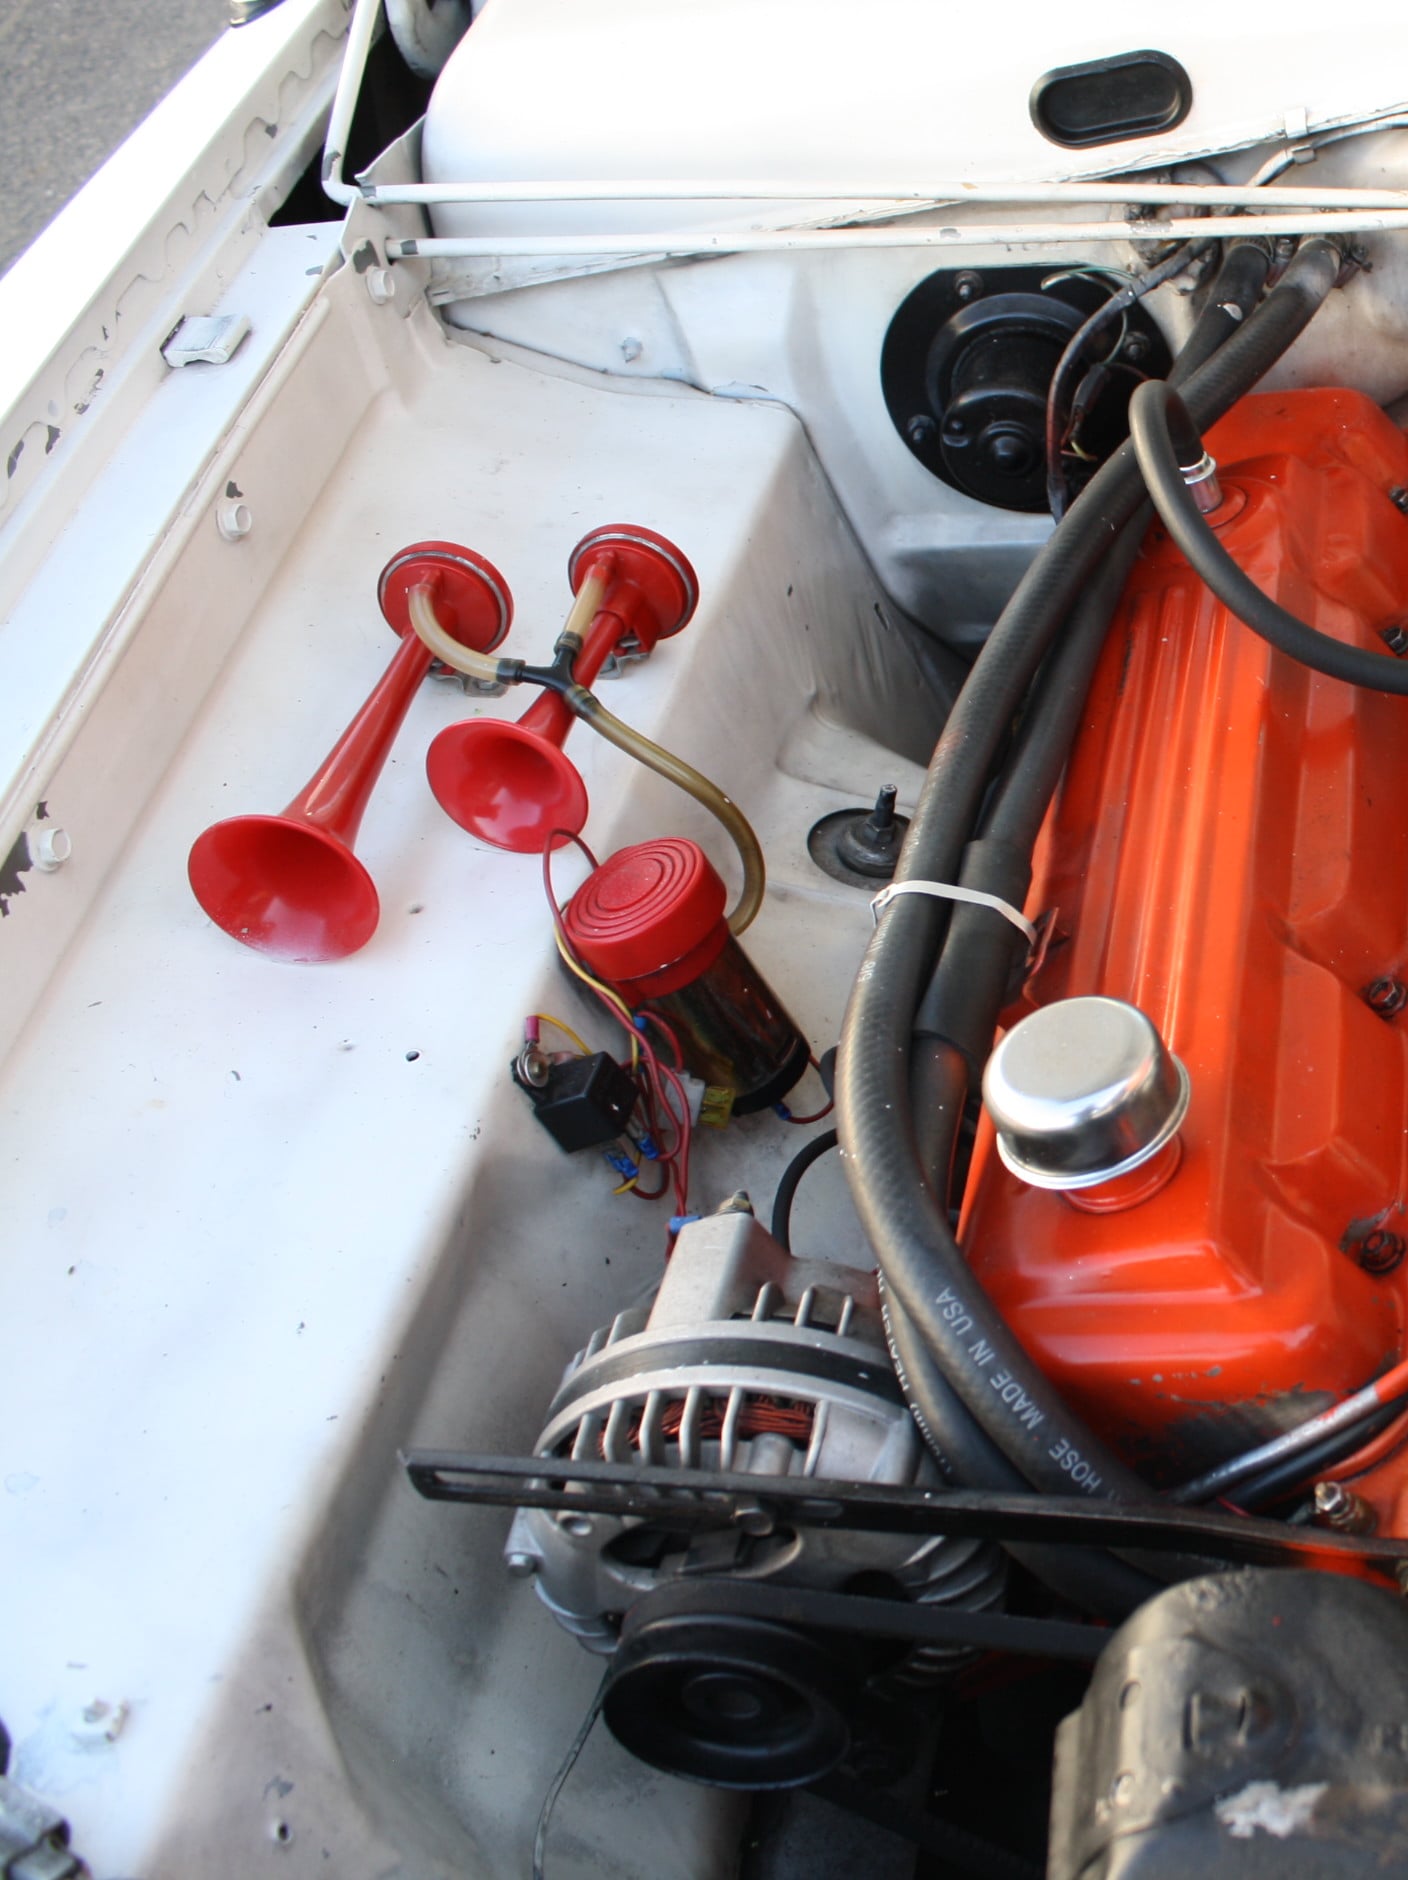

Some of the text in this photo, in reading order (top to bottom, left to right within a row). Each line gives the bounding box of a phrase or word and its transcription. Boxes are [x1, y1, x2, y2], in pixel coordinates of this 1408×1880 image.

[935, 1288, 1102, 1494] HOSE MADE IN USA
